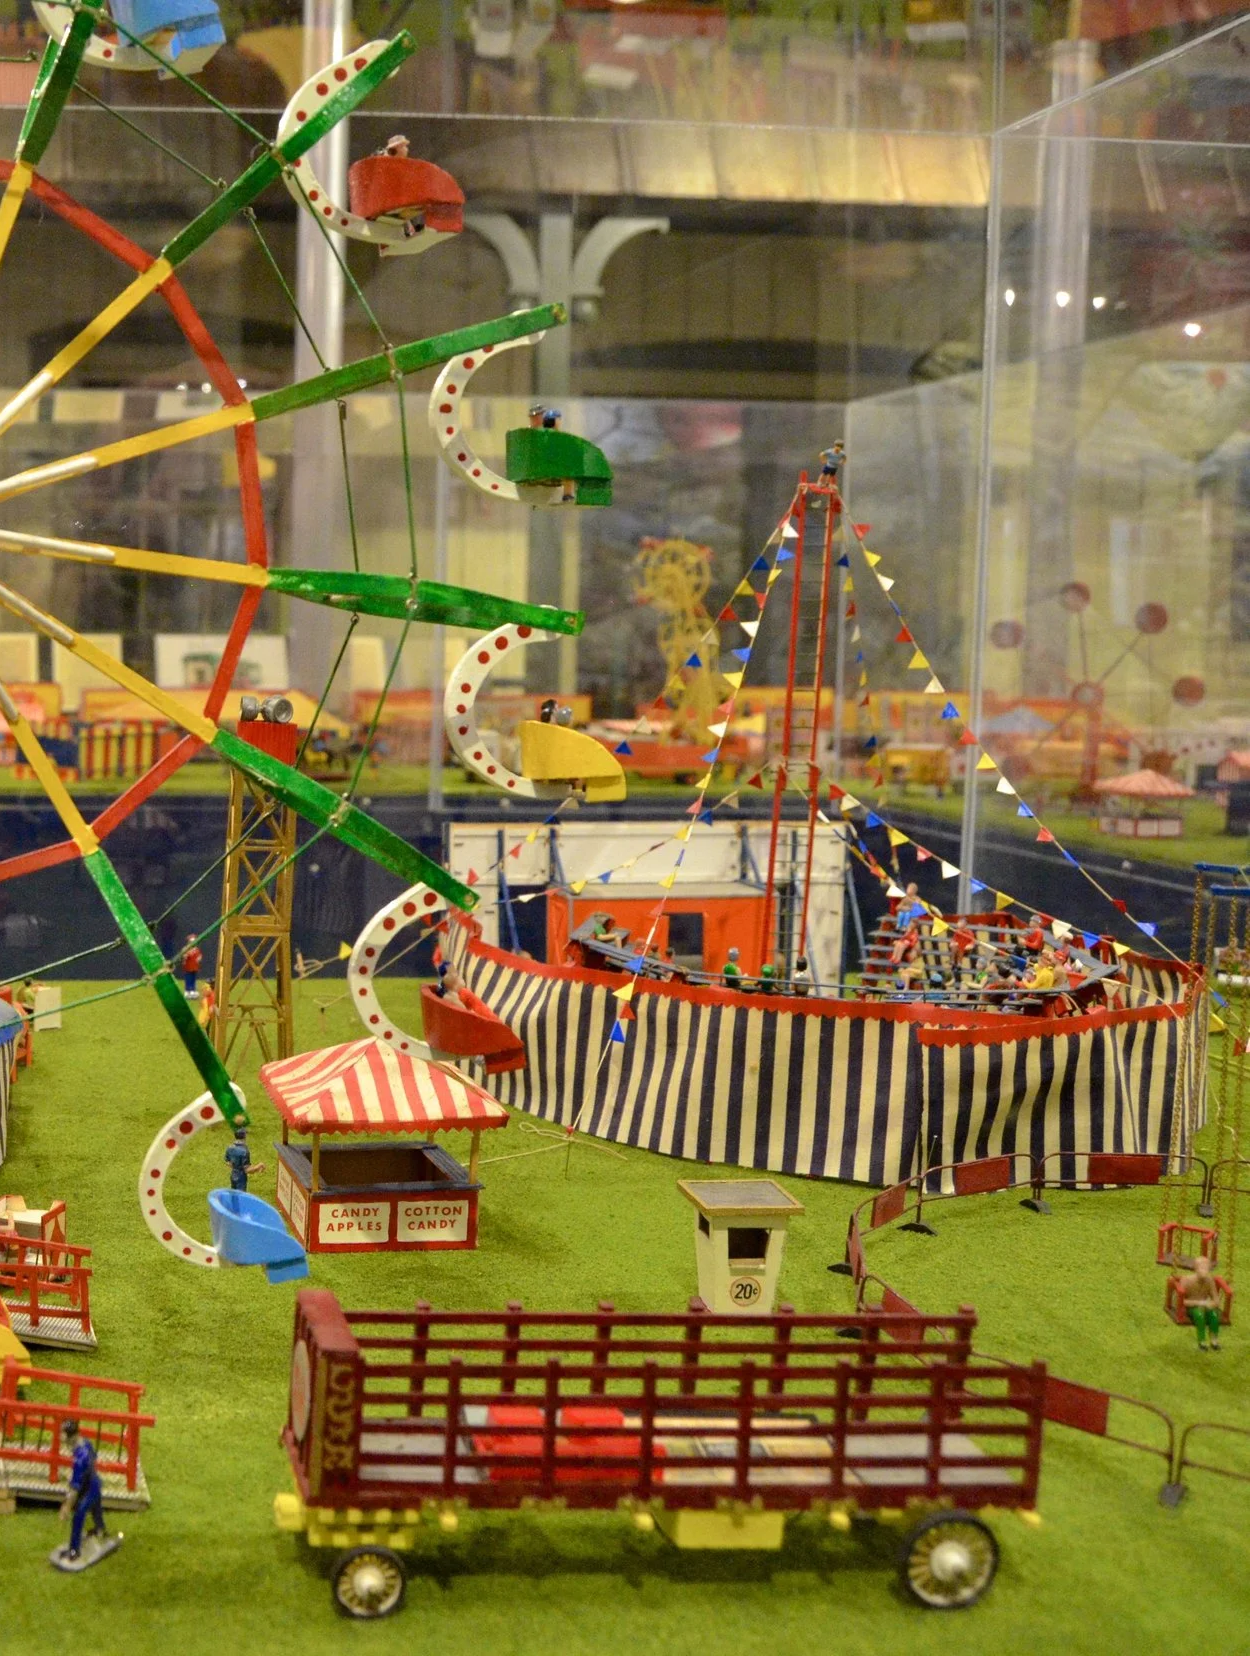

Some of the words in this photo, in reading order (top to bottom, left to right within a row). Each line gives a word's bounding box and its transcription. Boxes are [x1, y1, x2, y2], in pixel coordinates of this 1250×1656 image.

[331, 1207, 380, 1218] CANDY
[404, 1206, 463, 1217] COTTON
[326, 1221, 382, 1232] APPLES
[407, 1219, 457, 1231] CANDY
